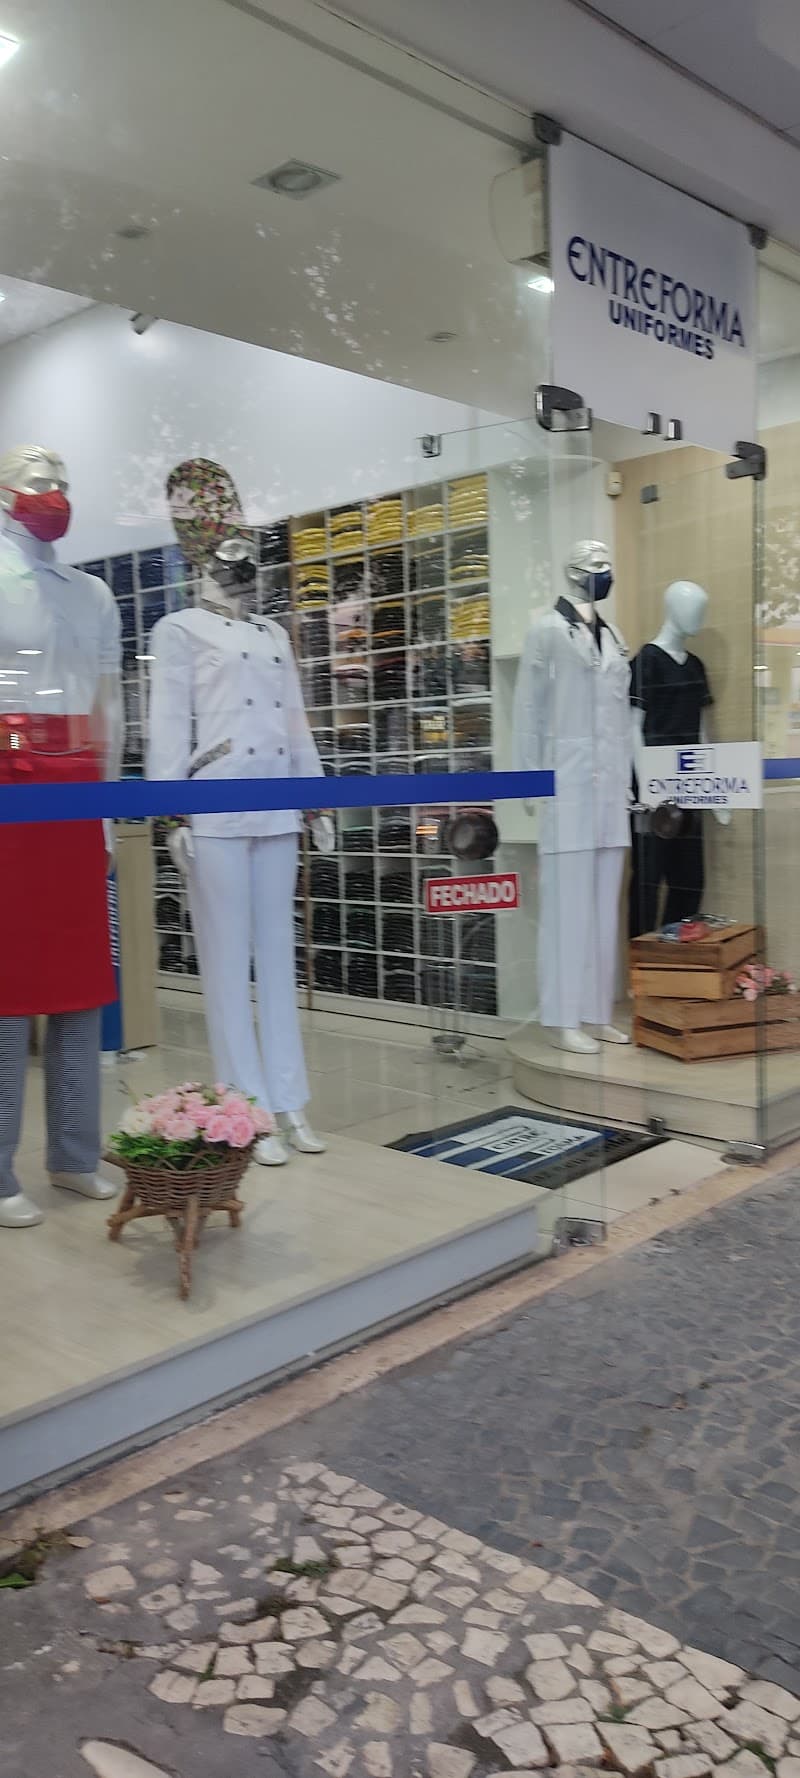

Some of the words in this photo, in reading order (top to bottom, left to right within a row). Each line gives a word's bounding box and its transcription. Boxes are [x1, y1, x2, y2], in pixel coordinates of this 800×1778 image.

[567, 236, 745, 347] ENTREFORMA
[609, 299, 714, 360] UNIFORMES
[648, 777, 751, 794] ENTREFORMA
[429, 880, 516, 907] FECHADO
